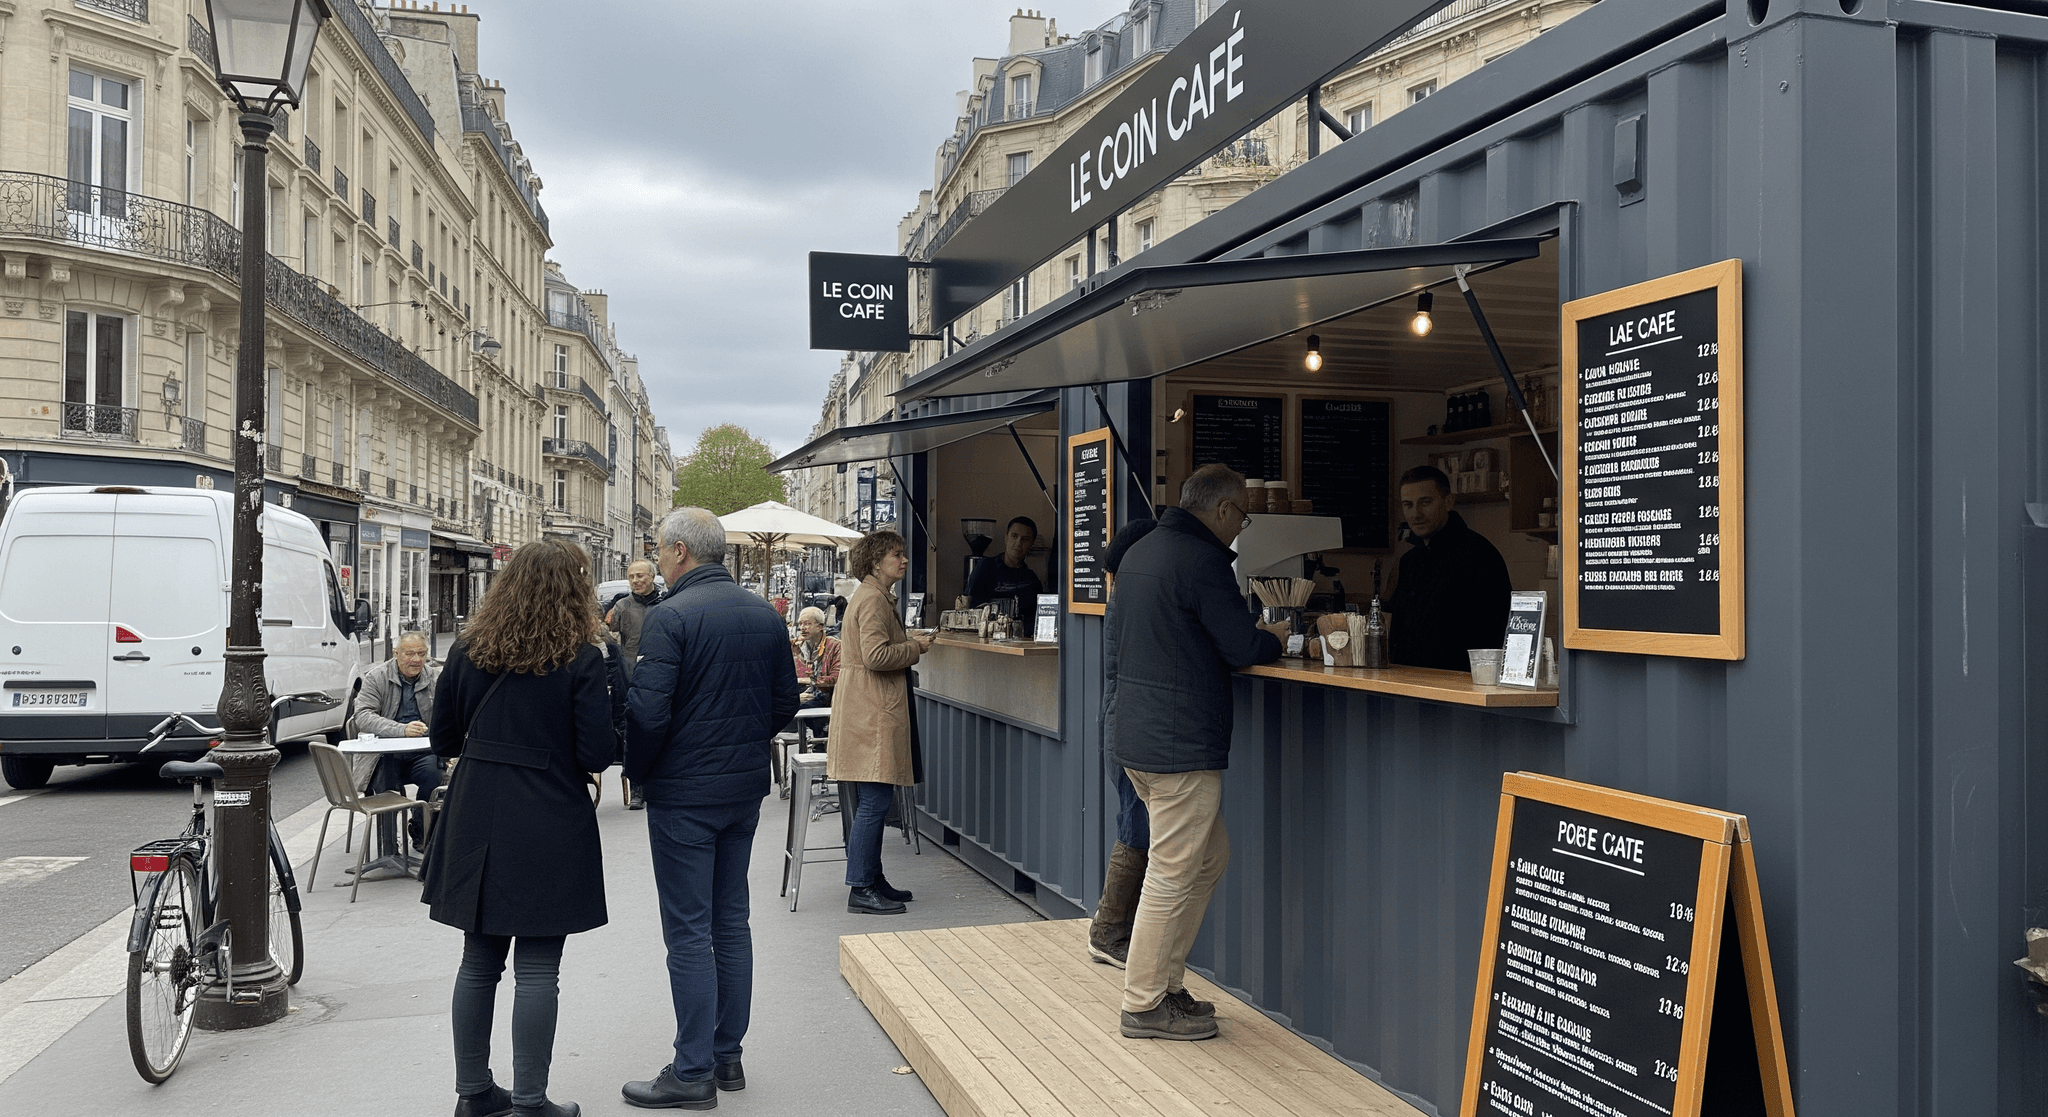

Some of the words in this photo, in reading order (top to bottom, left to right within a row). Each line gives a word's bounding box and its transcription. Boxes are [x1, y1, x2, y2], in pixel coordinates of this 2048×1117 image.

[1070, 149, 1092, 214] LE
[1097, 97, 1157, 191] COIN
[1166, 9, 1244, 141] CAFÉ
[823, 281, 842, 298] LE
[847, 283, 893, 301] COIN
[1609, 320, 1634, 346] LAE
[1637, 309, 1676, 339] CAFE
